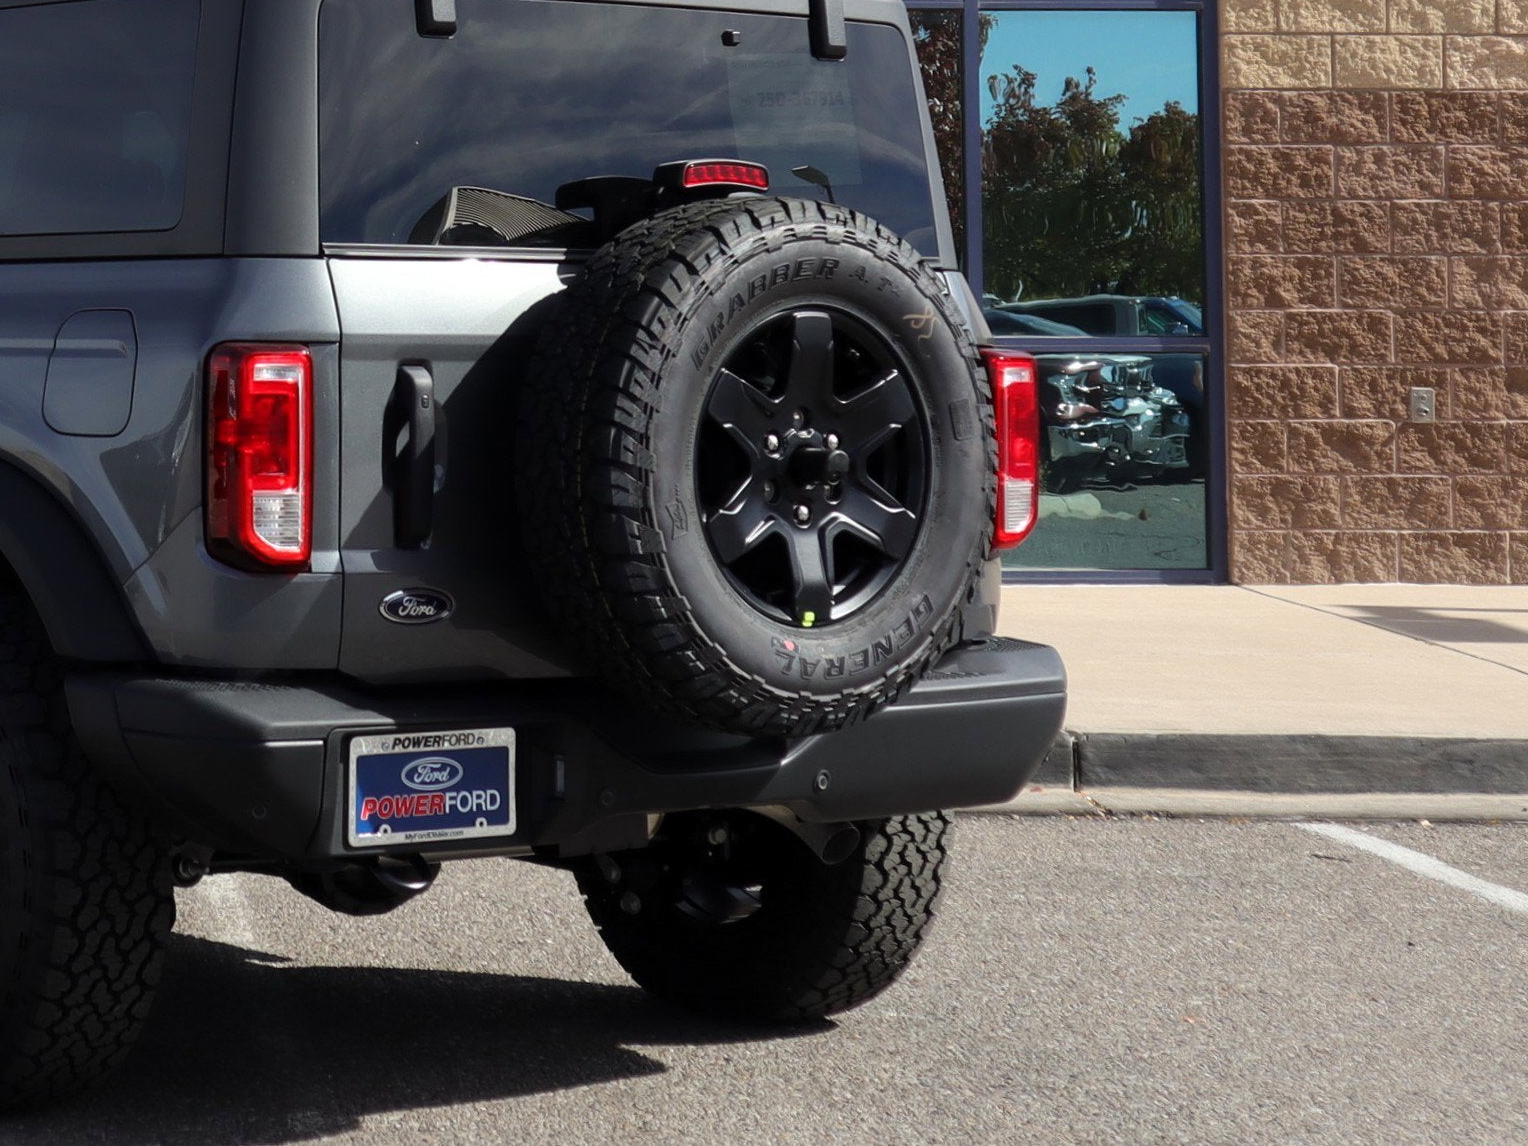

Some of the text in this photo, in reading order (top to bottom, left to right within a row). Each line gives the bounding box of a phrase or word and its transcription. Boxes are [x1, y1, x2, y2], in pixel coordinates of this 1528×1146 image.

[690, 256, 841, 372] GRABBER
[398, 595, 438, 617] Ford
[773, 592, 937, 681] GENERAL
[391, 732, 476, 751] POWERFORD
[413, 762, 451, 784] Ford
[360, 788, 501, 821] POWERFORD
